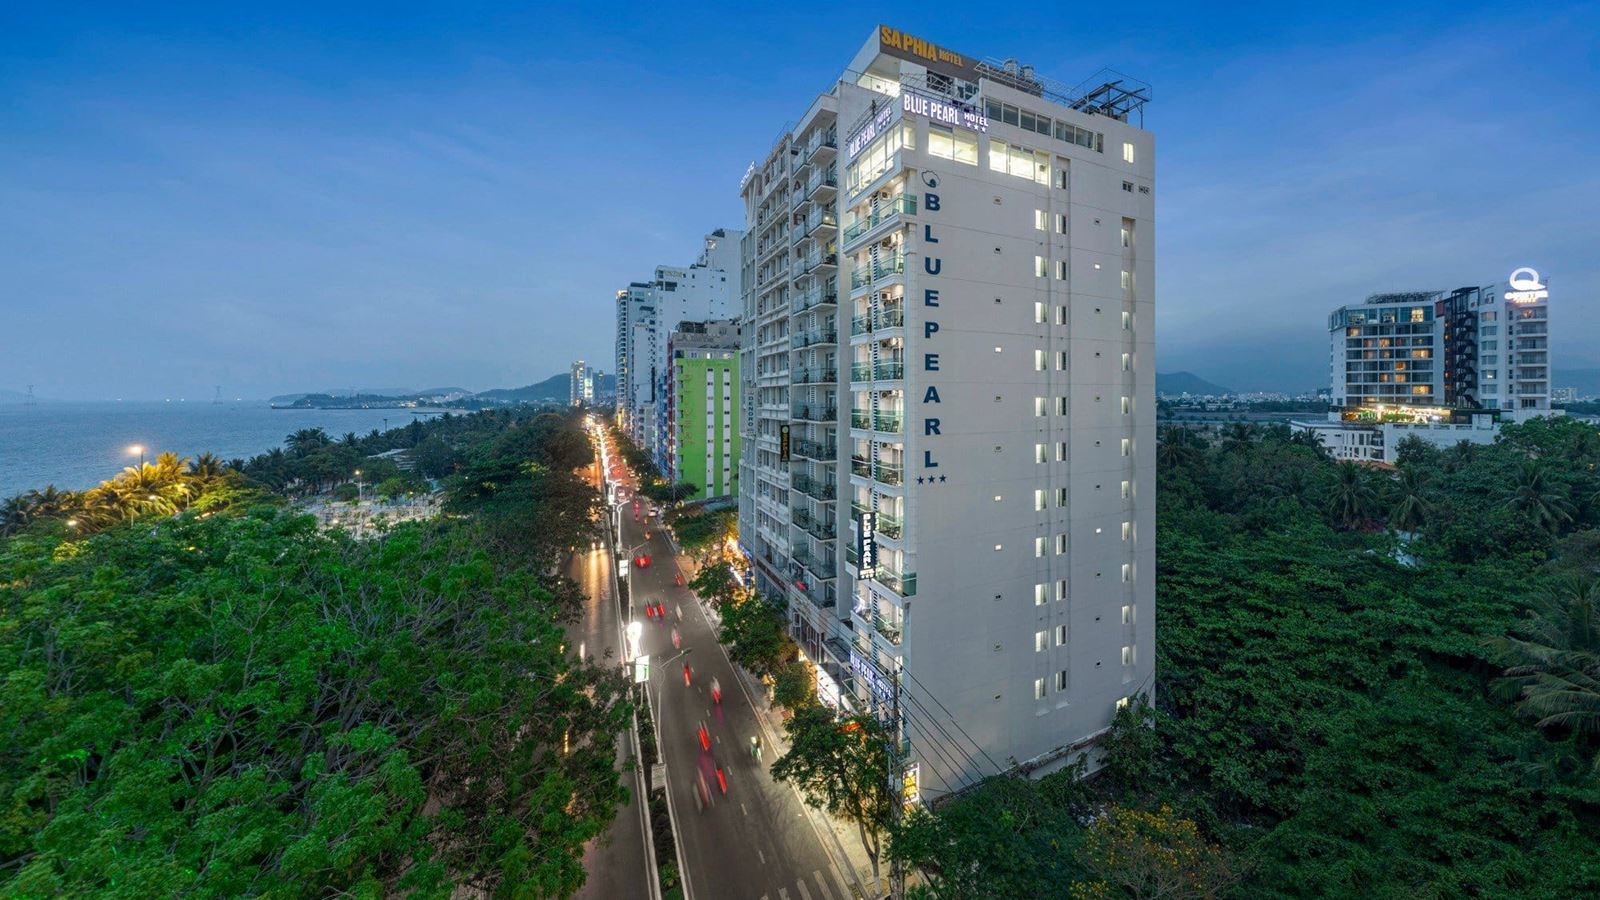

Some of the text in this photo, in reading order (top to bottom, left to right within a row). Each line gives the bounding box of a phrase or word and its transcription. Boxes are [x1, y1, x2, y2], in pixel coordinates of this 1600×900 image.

[939, 49, 963, 67] HOTEL
[904, 94, 989, 127] BLUE PEARL HOTEL
[863, 513, 871, 569] BLUE PEARL
